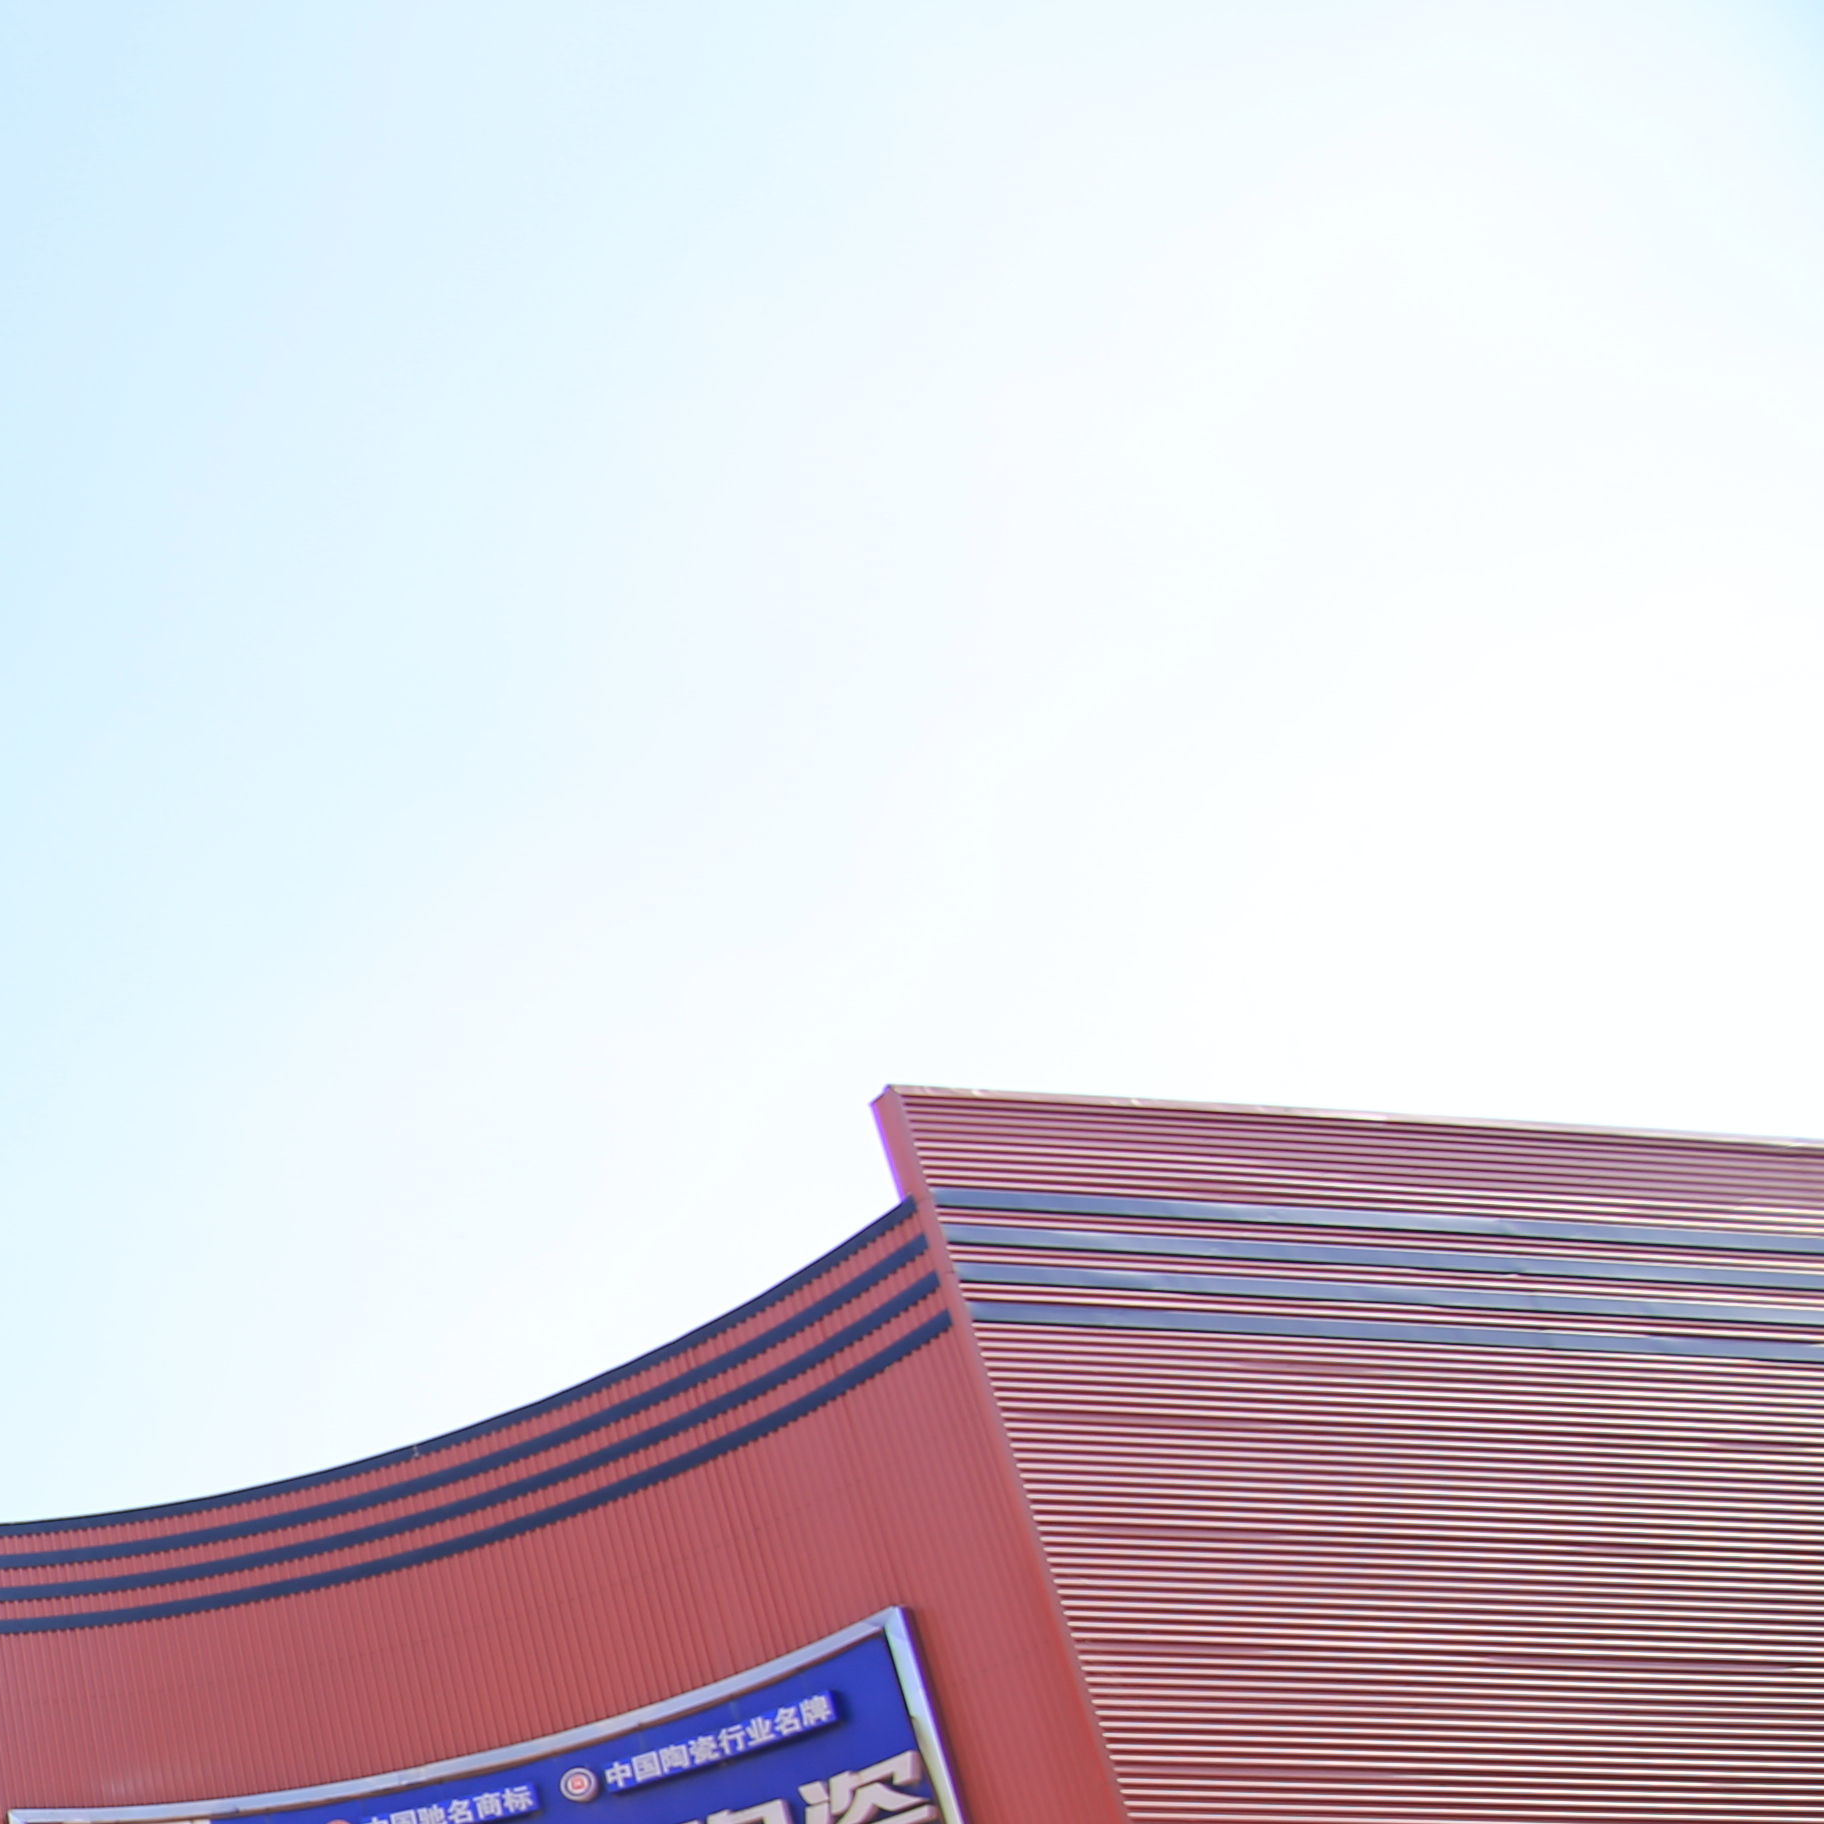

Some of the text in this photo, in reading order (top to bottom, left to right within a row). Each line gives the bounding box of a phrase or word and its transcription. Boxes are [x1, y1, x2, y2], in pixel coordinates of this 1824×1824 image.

[603, 1694, 834, 1790] 中国陶瓷行业名牌
